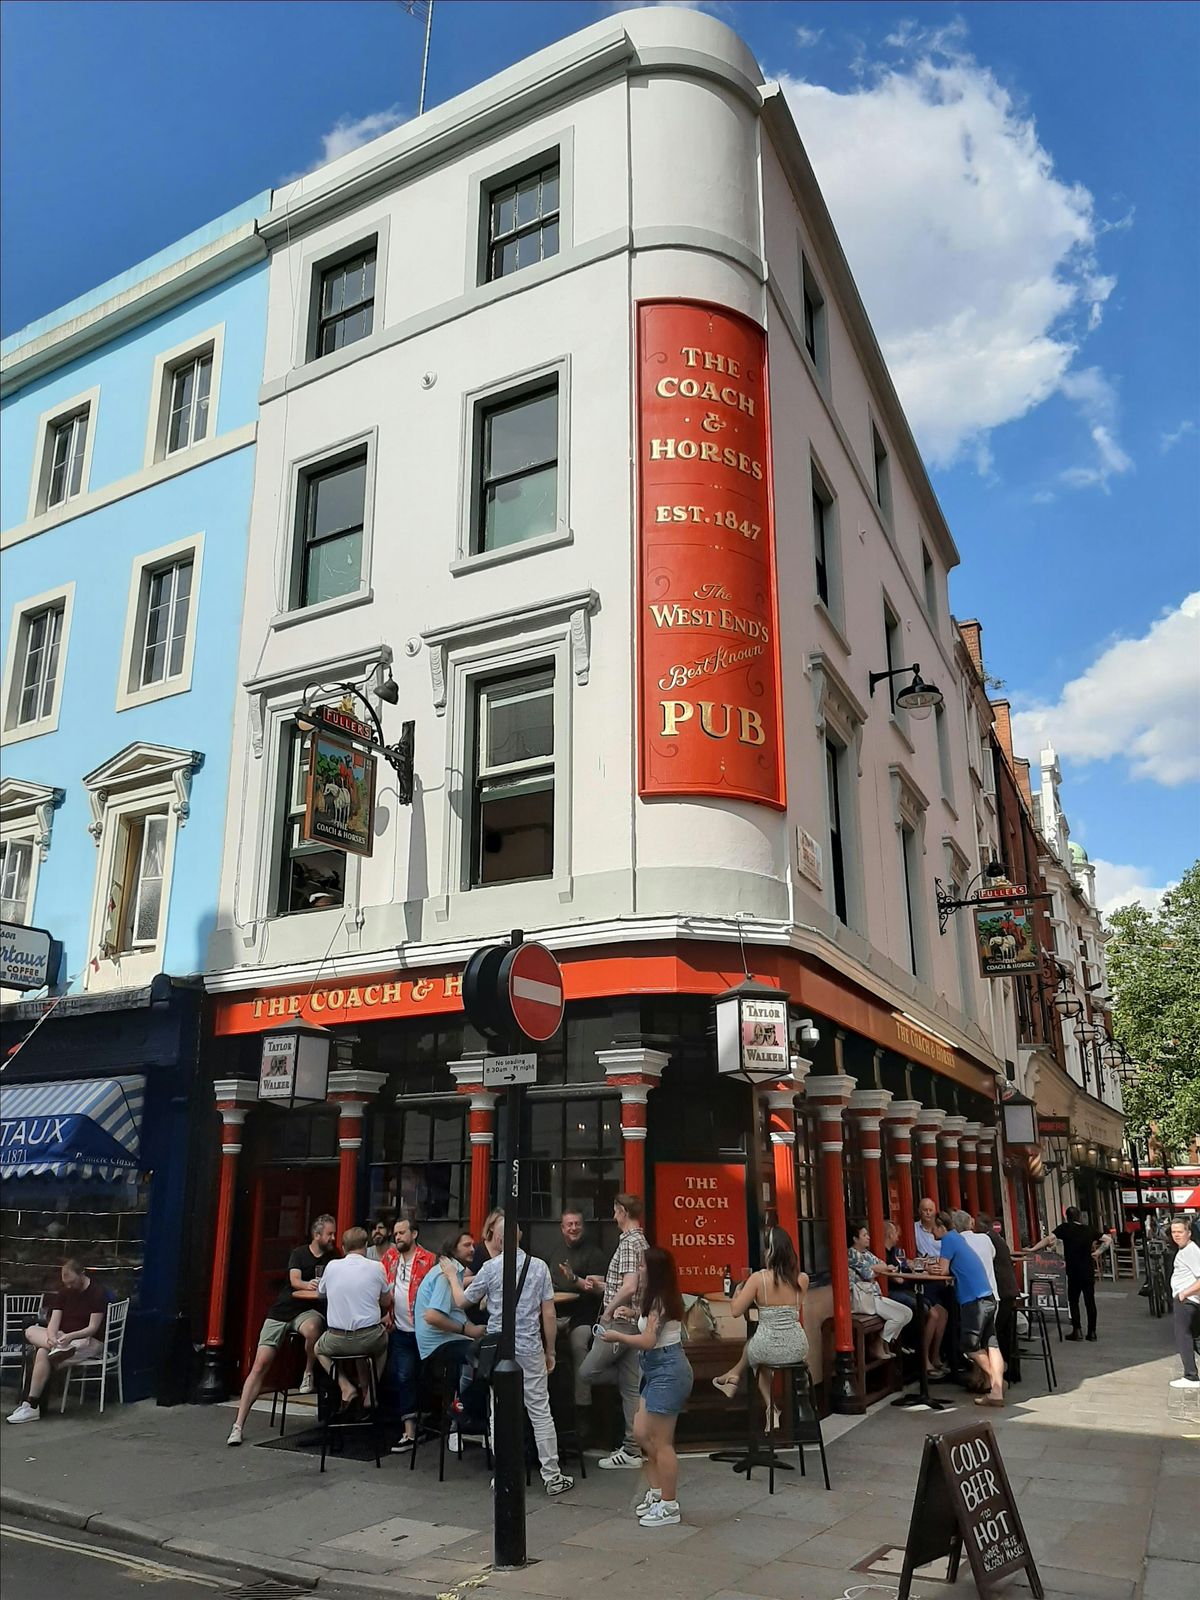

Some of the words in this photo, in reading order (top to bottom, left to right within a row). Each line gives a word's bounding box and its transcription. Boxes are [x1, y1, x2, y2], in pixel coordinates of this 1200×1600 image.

[681, 347, 740, 378] THE
[656, 377, 755, 416] COACH
[703, 412, 727, 433] &
[650, 439, 763, 480] HORSES
[656, 506, 710, 523] EST.
[715, 511, 762, 540] 1847
[693, 583, 733, 601] The
[650, 604, 716, 628] WEST
[719, 608, 769, 643] END'S
[658, 659, 711, 691] Best
[710, 644, 764, 675] Known
[659, 700, 766, 746] PUB
[316, 822, 337, 836] COACH
[343, 831, 366, 845] HORSES
[0, 929, 16, 940] son
[7, 965, 39, 976] COFFEE
[253, 994, 300, 1018] THE
[309, 981, 401, 1012] COACH
[411, 976, 433, 1001] &
[746, 1005, 780, 1018] TAYLOR
[267, 1041, 292, 1051] TAYLOR
[896, 1021, 910, 1044] THE
[910, 1030, 930, 1056] COACH
[746, 1049, 784, 1062] WALKER
[263, 1079, 290, 1090] WALKER
[0, 1118, 71, 1146] TAUX
[685, 1177, 717, 1189] THE
[674, 1196, 728, 1209] COACH
[695, 1215, 707, 1228] &
[672, 1234, 735, 1246] HORSES
[680, 1266, 702, 1276] EST.
[950, 1438, 990, 1475] COLD
[960, 1469, 1000, 1512] BEER
[980, 1508, 992, 1519] TOO
[973, 1510, 1009, 1551] HOT
[983, 1544, 1000, 1561] UNDER
[1000, 1535, 1017, 1549] THESE
[984, 1553, 1005, 1572] BLOODY
